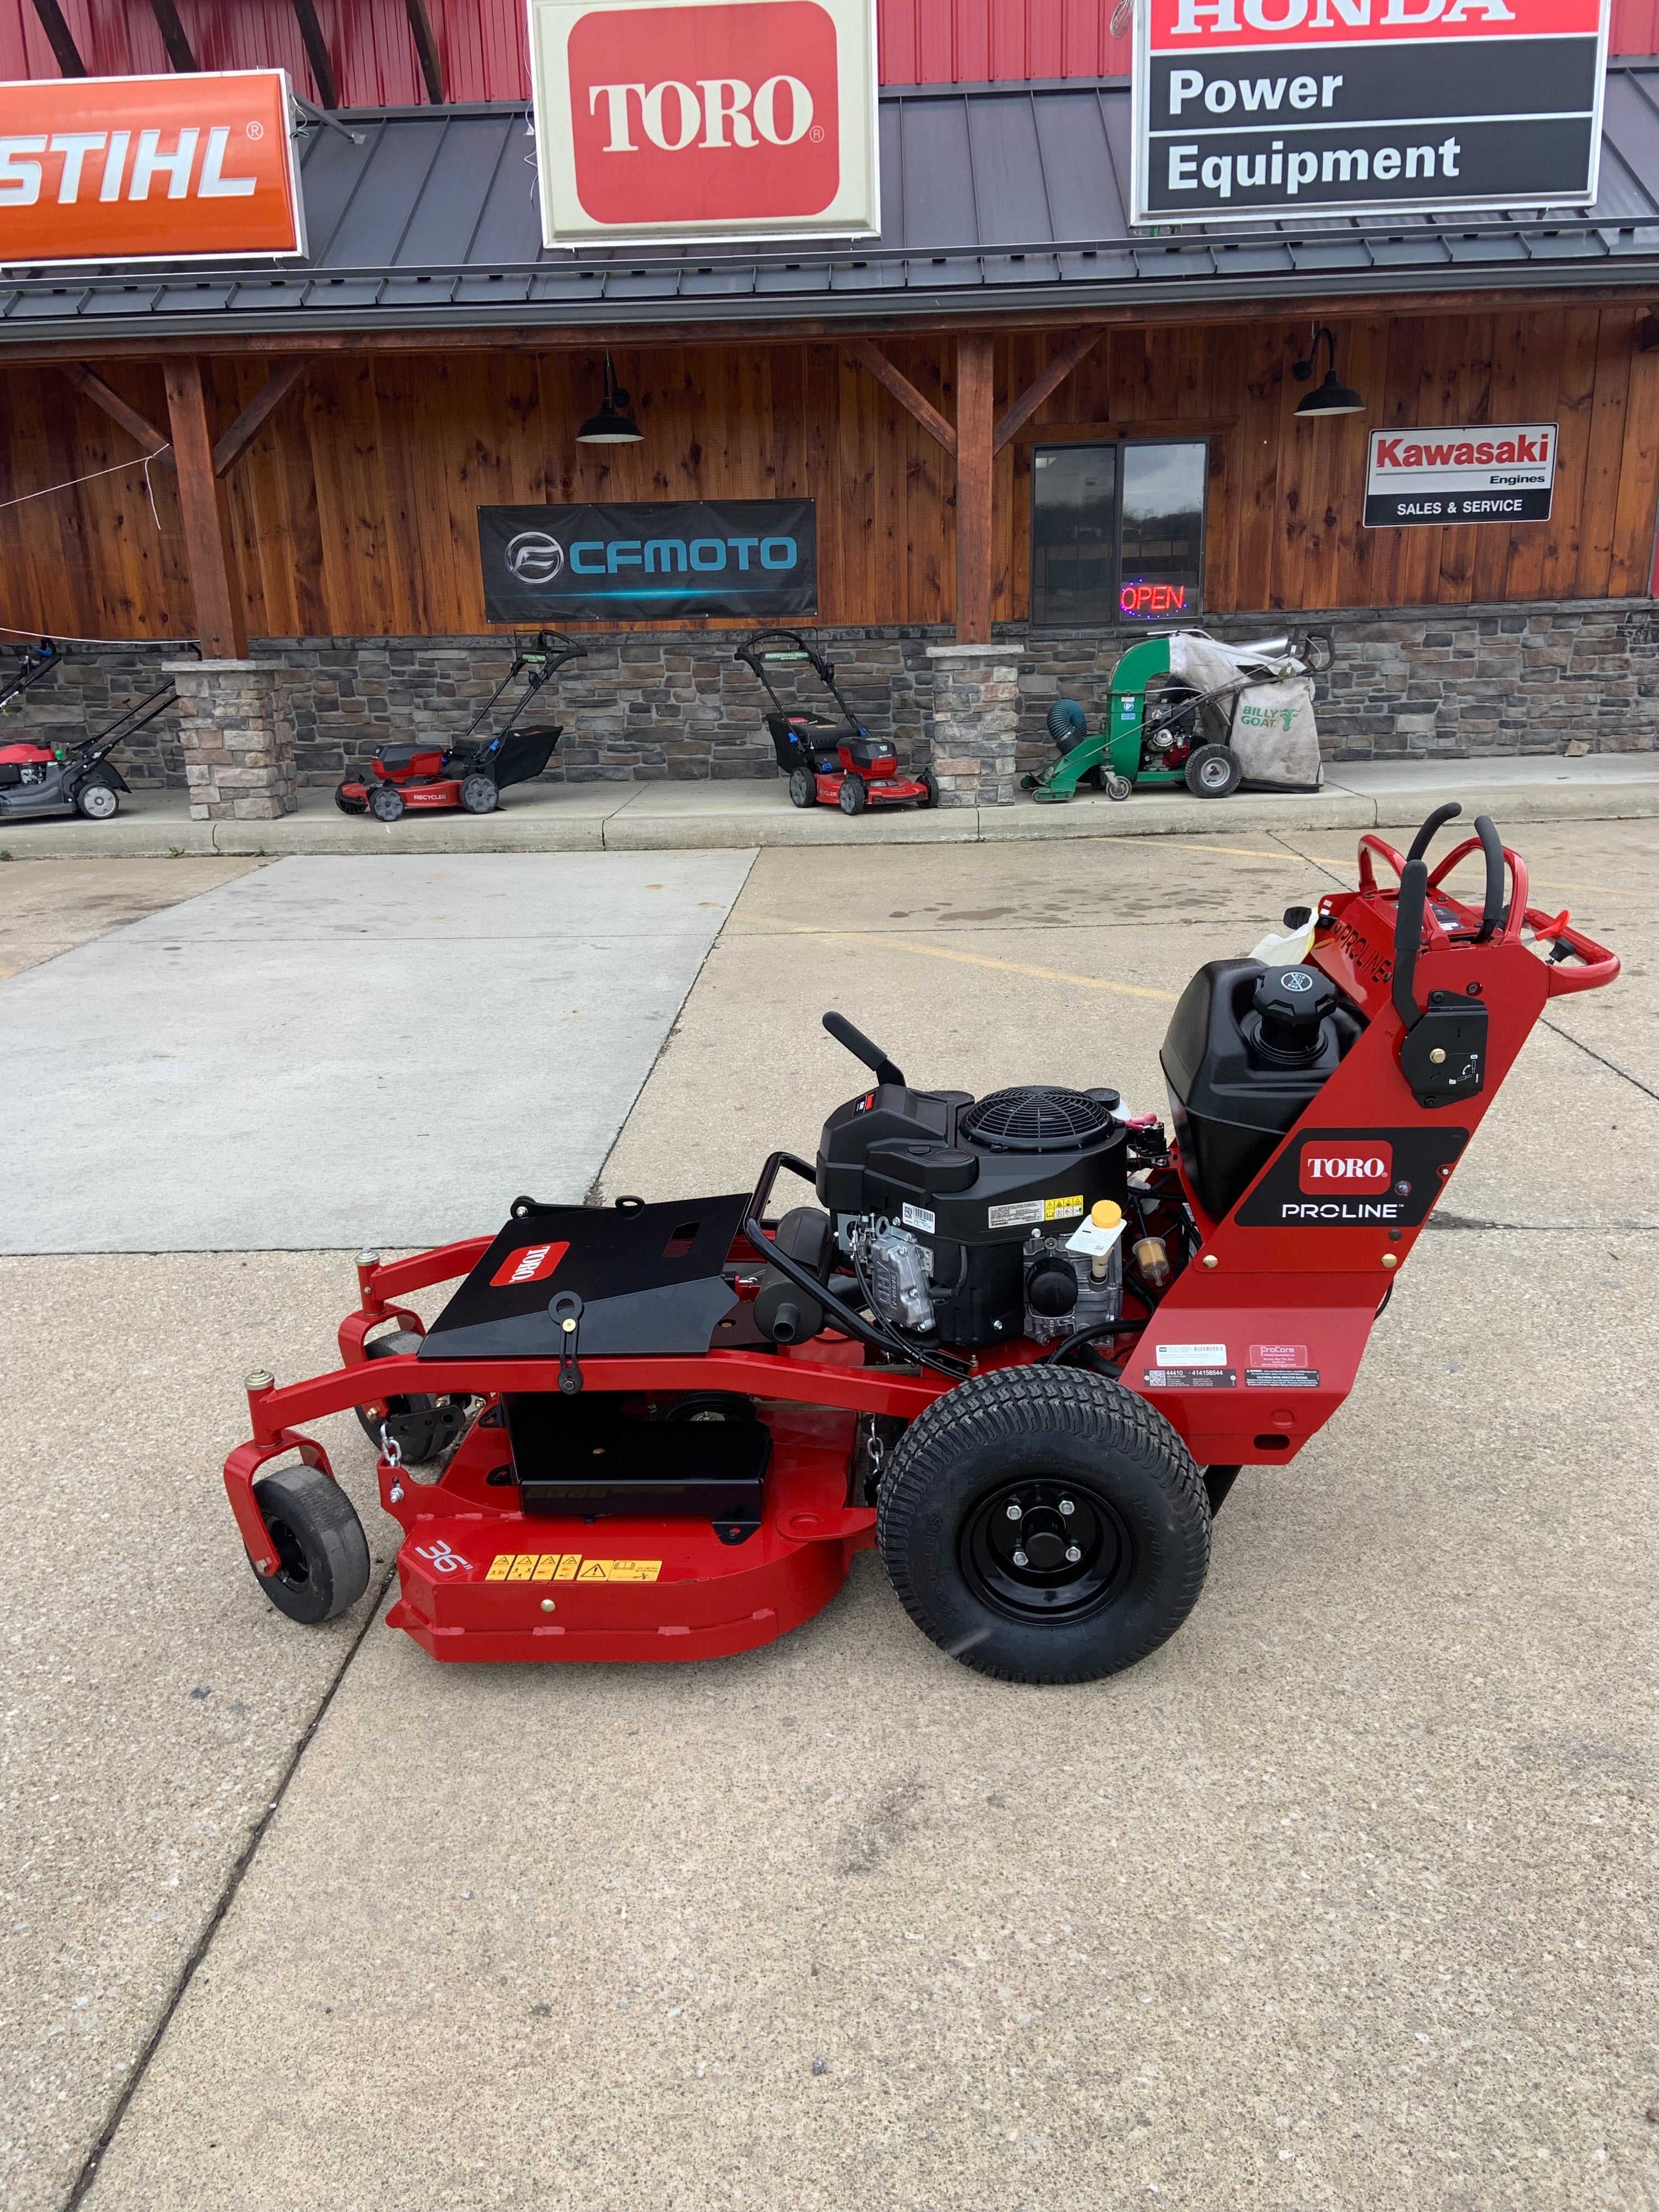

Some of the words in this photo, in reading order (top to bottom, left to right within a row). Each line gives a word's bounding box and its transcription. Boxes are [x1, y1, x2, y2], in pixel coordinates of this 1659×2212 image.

[1170, 0, 1515, 35] HONDA
[1169, 69, 1344, 115] Power
[589, 75, 814, 153] TORO
[0, 126, 257, 206] STIHL
[1168, 137, 1460, 198] Equipment
[1376, 433, 1549, 468] Kawasaki
[1489, 475, 1545, 485] Engines
[1397, 503, 1442, 516] SALES
[1447, 501, 1457, 514] &
[1463, 499, 1523, 513] SERVICE
[569, 537, 797, 574] CFMOTO
[1120, 584, 1184, 610] OPEN
[1243, 706, 1279, 718] BILLY
[1335, 923, 1392, 983] PROLINE
[1307, 1158, 1385, 1178] TORO
[1282, 1204, 1398, 1218] PROLINE
[511, 1245, 551, 1280] TORO
